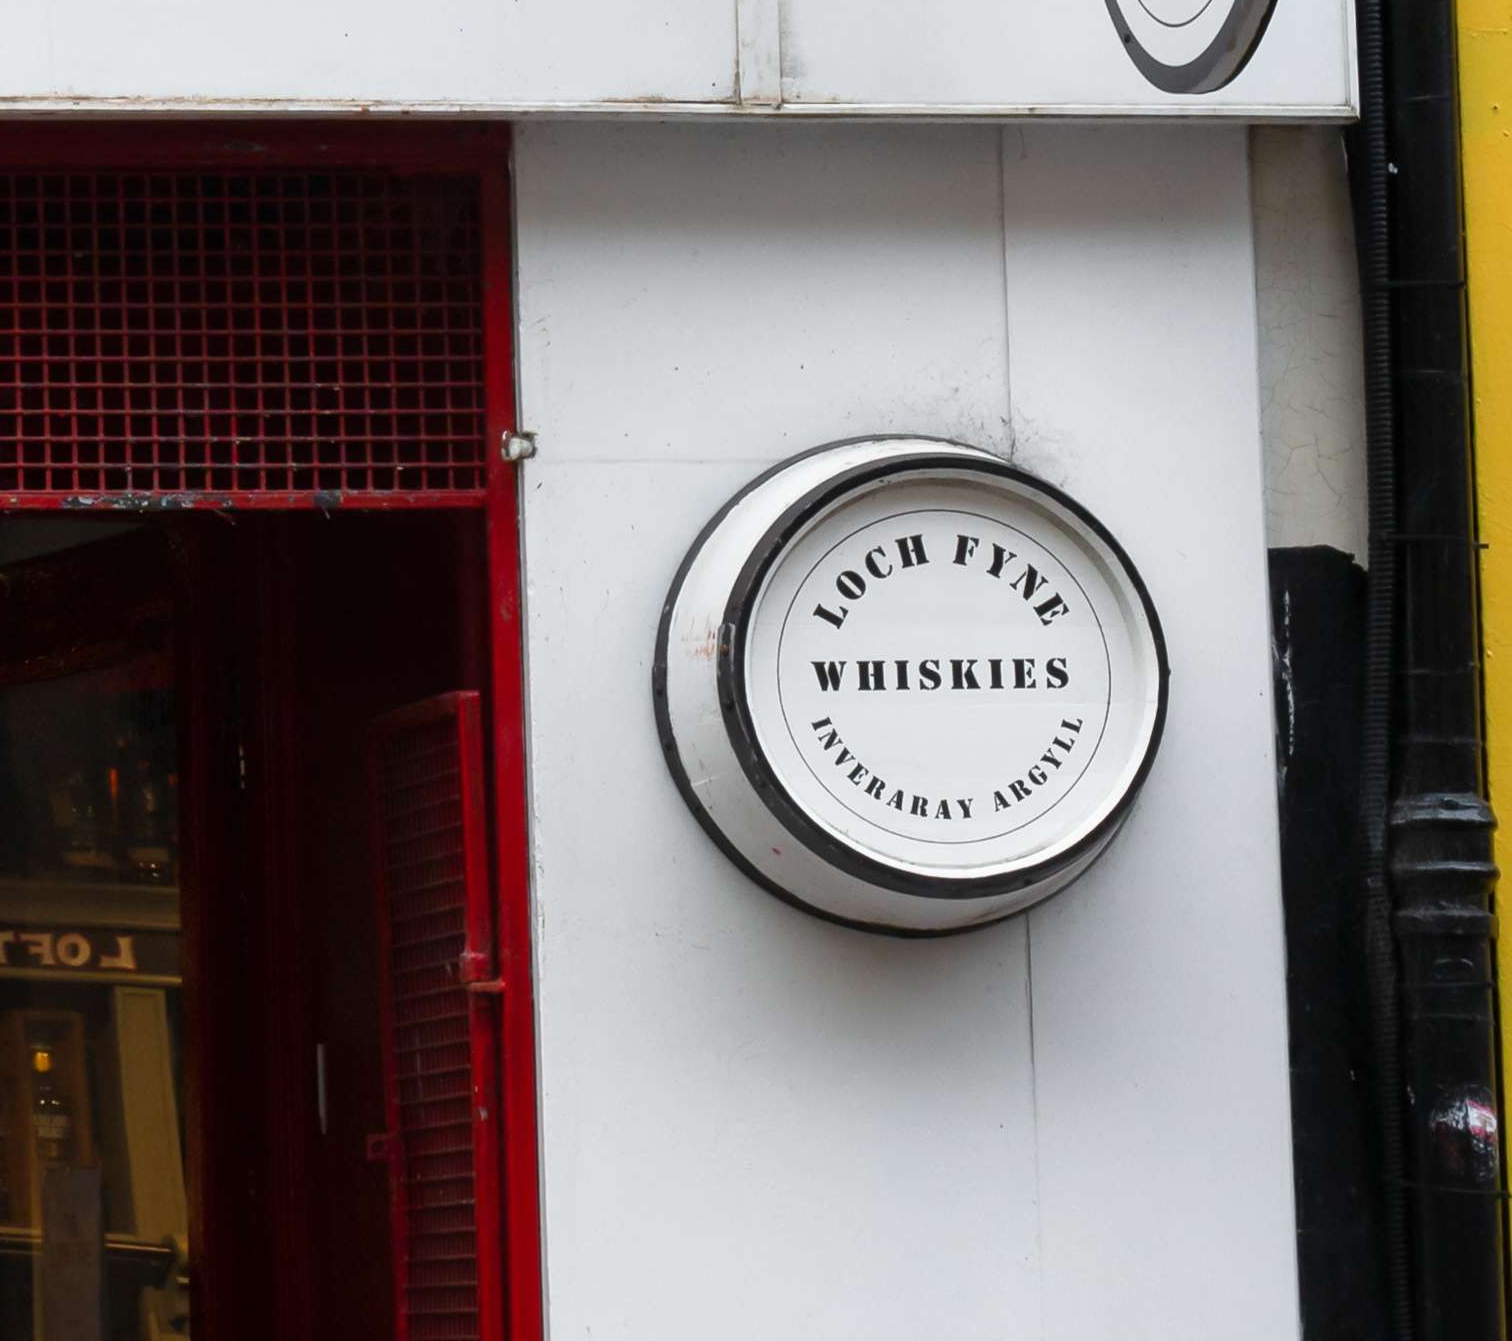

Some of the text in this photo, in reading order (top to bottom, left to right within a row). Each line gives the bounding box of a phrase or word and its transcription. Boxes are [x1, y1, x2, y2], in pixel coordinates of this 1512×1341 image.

[811, 533, 1071, 631] LOCH FYNE
[811, 657, 1070, 692] WHISKIES
[811, 714, 1084, 821] INVERARAY ARGYLL
